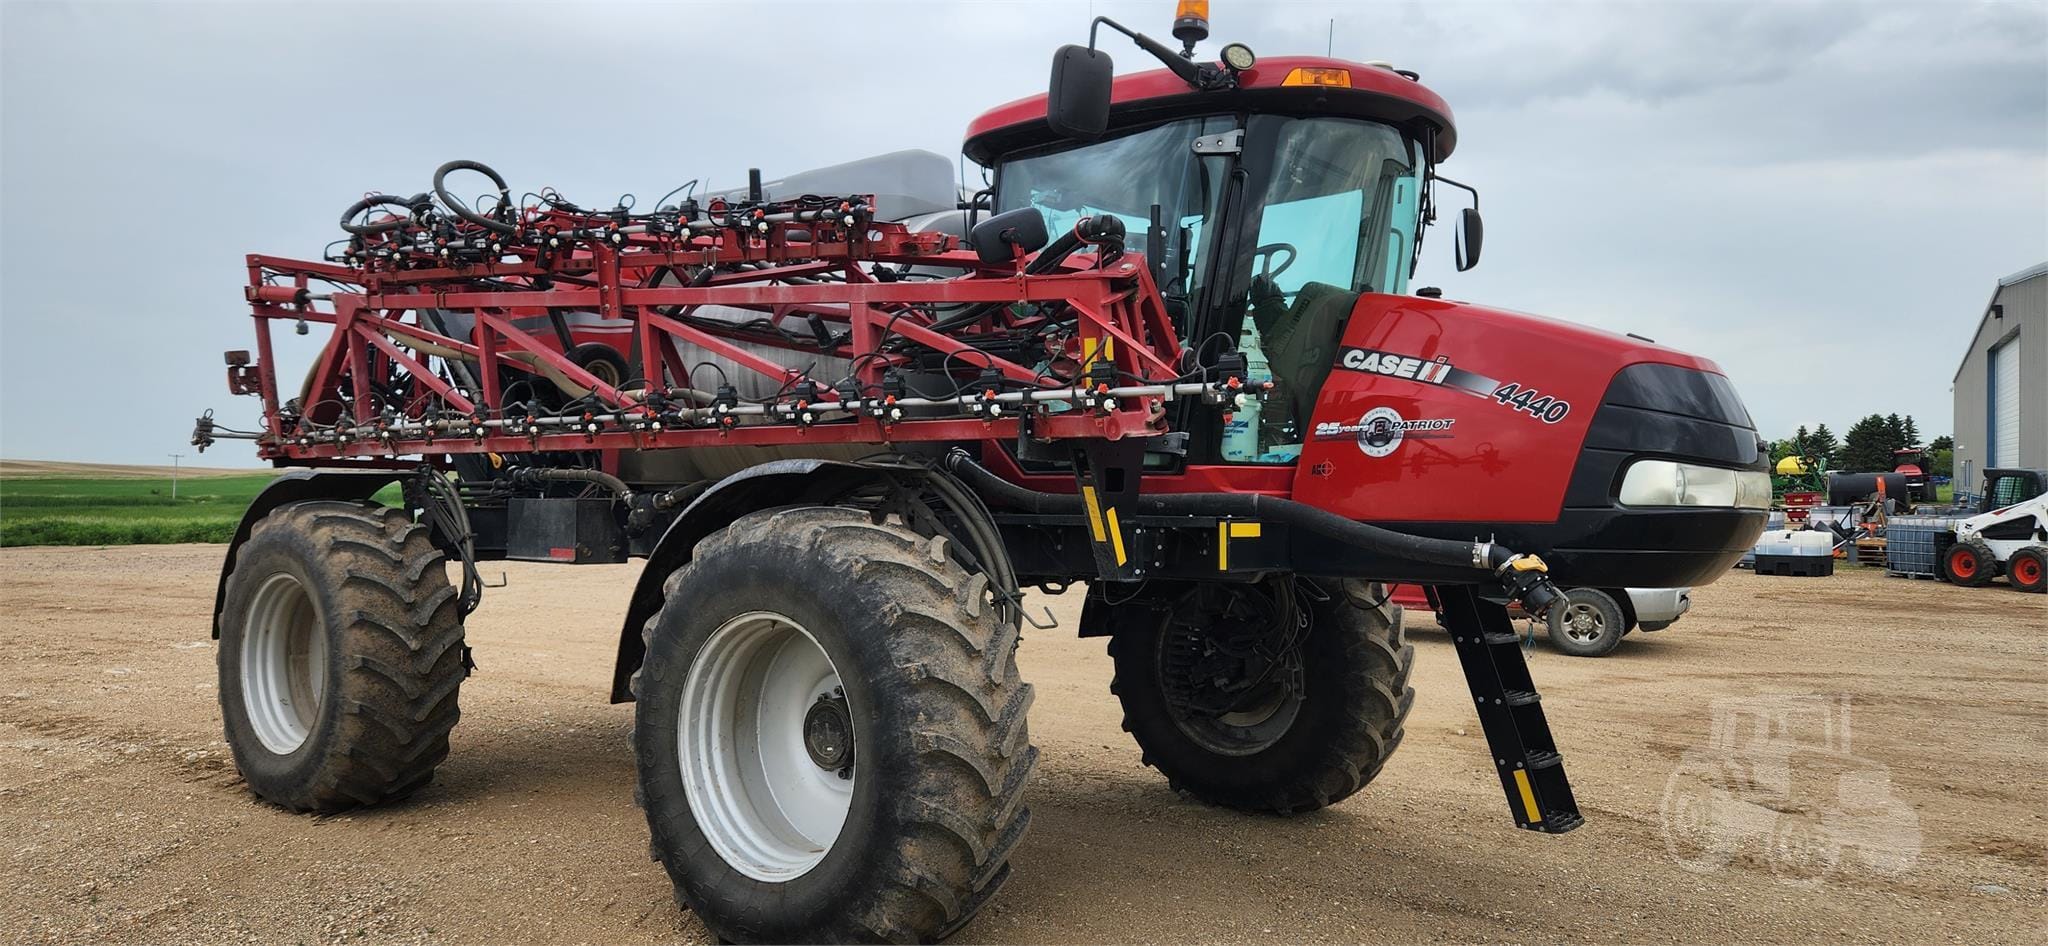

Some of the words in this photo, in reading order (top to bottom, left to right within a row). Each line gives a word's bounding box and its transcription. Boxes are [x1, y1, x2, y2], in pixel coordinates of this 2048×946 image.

[1343, 349, 1422, 379] CASE
[1492, 382, 1570, 424] 4440
[1390, 419, 1455, 431] PATRIOT
